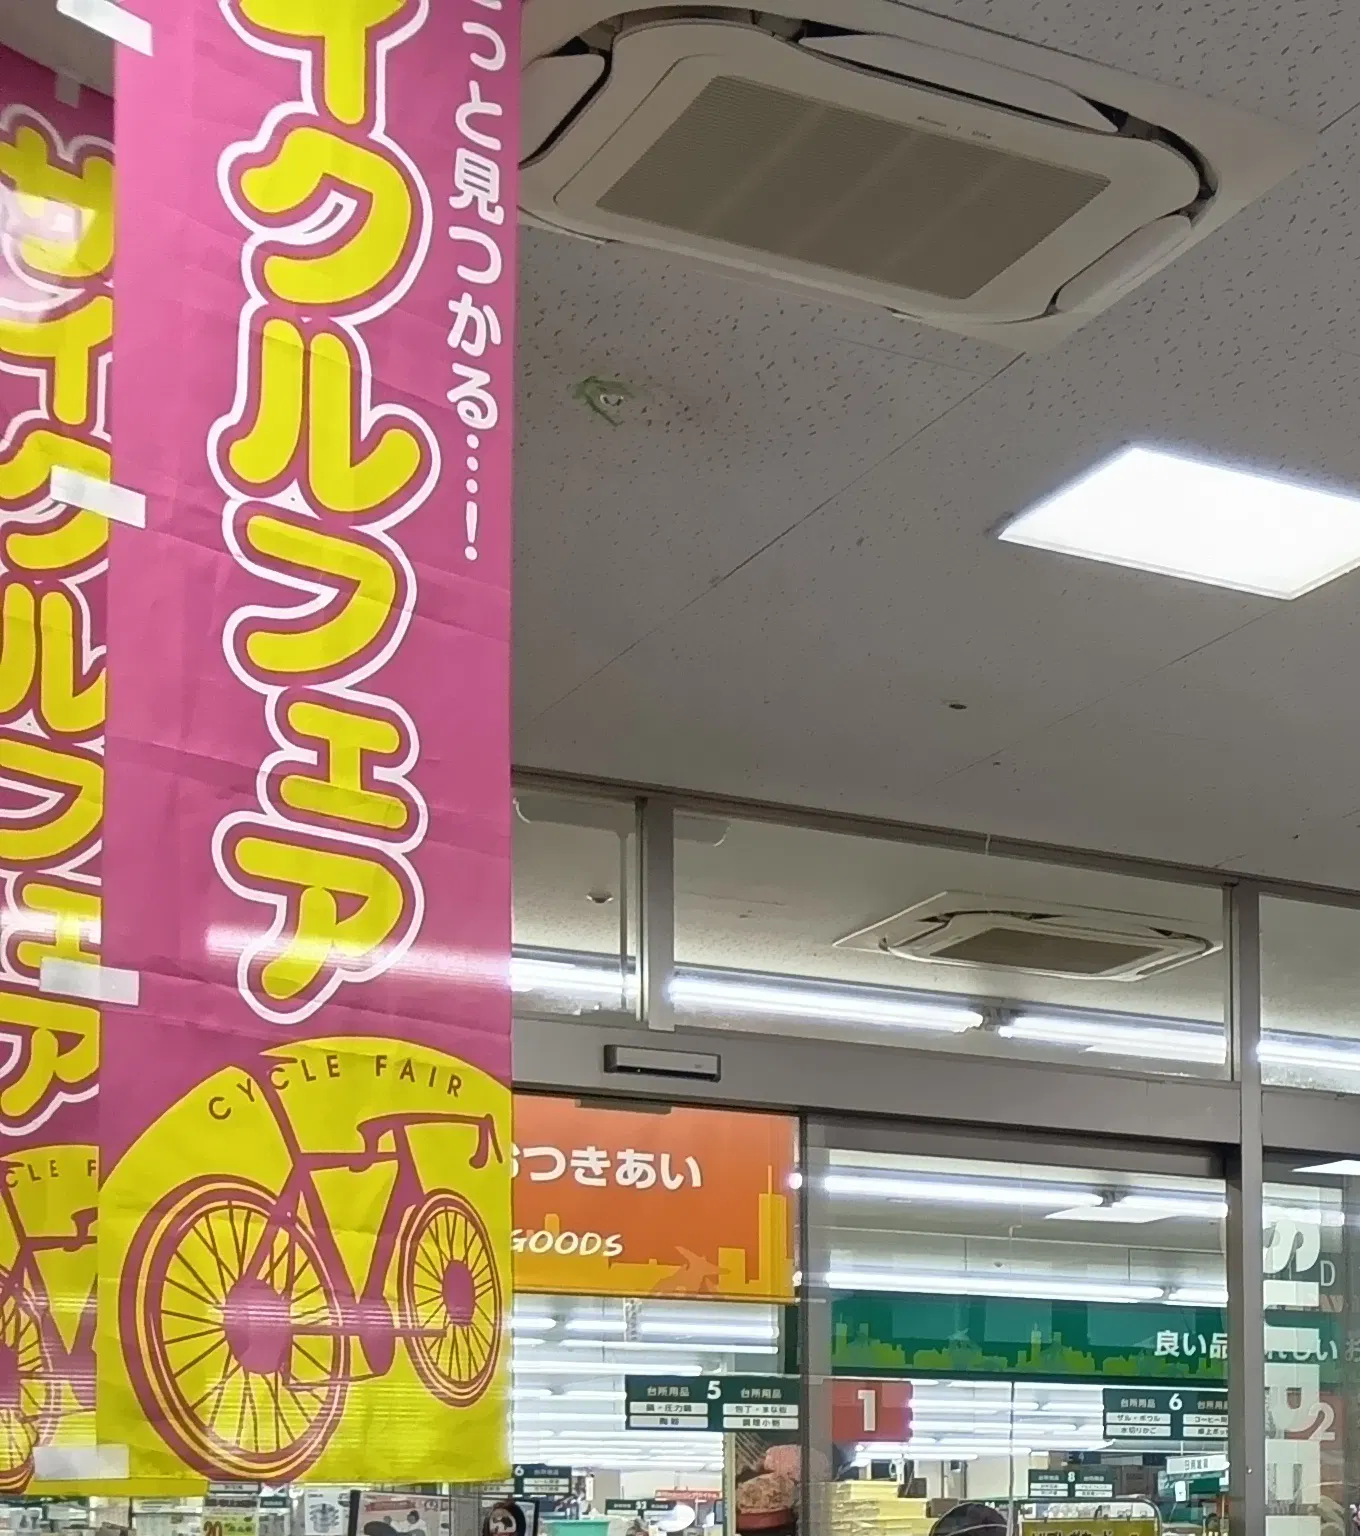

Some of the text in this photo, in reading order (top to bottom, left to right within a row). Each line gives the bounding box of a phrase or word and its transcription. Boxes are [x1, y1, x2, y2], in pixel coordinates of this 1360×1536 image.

[208, 1053, 463, 1122] CYCLE FAIR
[707, 1381, 721, 1398] 5
[1169, 1393, 1182, 1410] 6
[858, 1389, 876, 1432] 1
